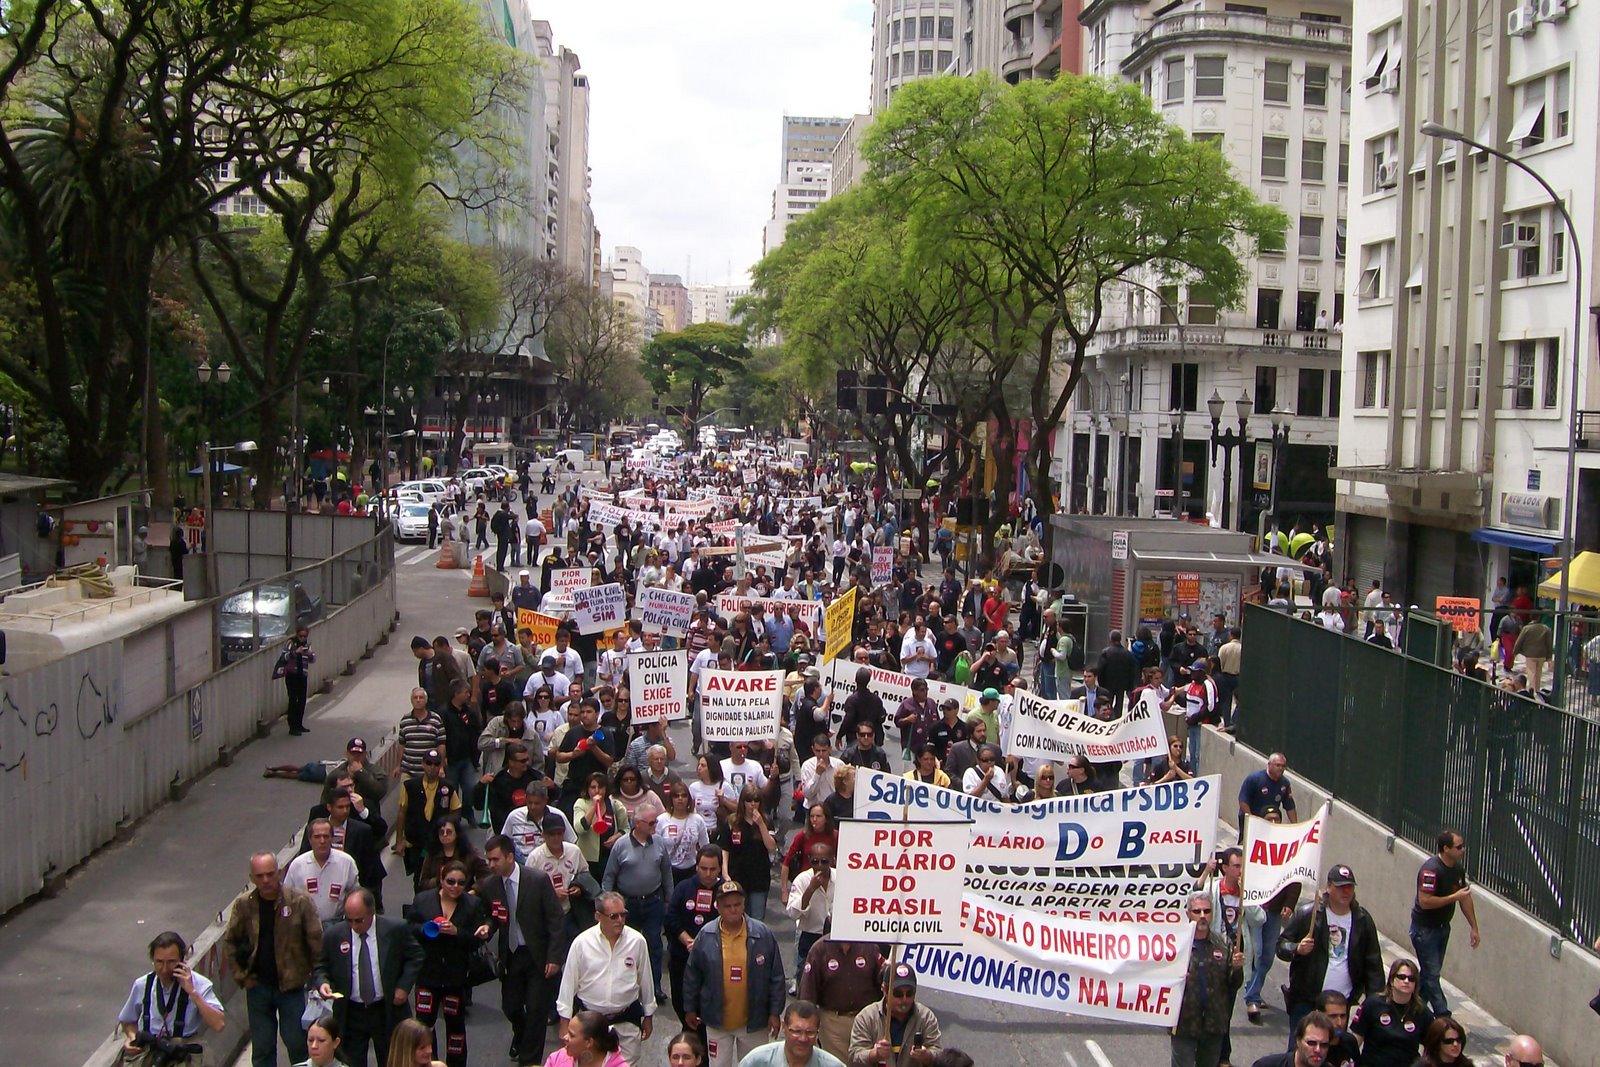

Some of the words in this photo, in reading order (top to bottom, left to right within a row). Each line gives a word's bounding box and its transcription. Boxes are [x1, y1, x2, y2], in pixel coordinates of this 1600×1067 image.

[553, 578, 587, 587] SALÁRIO
[561, 570, 580, 578] PIOR
[574, 587, 602, 602] POLÍCIA
[649, 590, 677, 604] CHEGA
[679, 596, 690, 606] DE
[592, 611, 616, 622] SIM
[1440, 604, 1476, 618] OURO
[643, 610, 670, 626] POLÍCIA
[672, 617, 690, 630] CIVIL
[531, 632, 551, 644] OSO
[638, 653, 678, 670] POLÍCIA
[644, 672, 670, 685] CIVIL
[706, 674, 777, 692] AVARÉ
[824, 676, 856, 695] Puniçã
[868, 667, 911, 688] OVERNAD
[643, 686, 672, 701] EXIGE
[712, 697, 724, 707] NA
[726, 697, 747, 707] LUTA
[749, 696, 770, 707] PELA
[635, 702, 681, 718] RESPEITO
[705, 710, 742, 721] DIGNIDADE
[743, 710, 775, 721] SALARIAL
[1019, 696, 1057, 724] CHEGA
[1057, 713, 1078, 731] DE
[1077, 720, 1107, 736] NOS
[705, 726, 715, 736] DA
[716, 723, 744, 736] POLÍCIA
[745, 724, 774, 736] PAULISTA
[1016, 733, 1035, 748] COM
[1036, 736, 1041, 748] A
[1042, 736, 1076, 756] CONVERSA
[1076, 745, 1087, 756] DA
[869, 774, 929, 808] Sabe
[936, 790, 951, 809] o
[874, 829, 934, 847] PIOR
[968, 829, 1045, 850] ALÁRIO
[1117, 821, 1203, 860] BRASIL
[1249, 820, 1321, 866] AVAE
[847, 848, 956, 871] SALÁRIO
[881, 875, 916, 893] DO
[964, 877, 1047, 893] POLICIAIS
[1053, 882, 1120, 896] PEDEM
[1124, 883, 1191, 896] REPOS
[852, 897, 942, 915] BRASIL
[1031, 895, 1112, 908] APARTIR
[1119, 899, 1147, 909] DA
[864, 918, 910, 933] POLÍCIA
[913, 920, 943, 933] CIVIL
[972, 906, 1018, 944] ESTÁ
[1023, 921, 1035, 947] O
[1040, 924, 1131, 961] DINHEIRO
[1138, 933, 1178, 962] DOS
[901, 943, 1071, 1001] FUNCIONÁRIOS
[1078, 976, 1109, 1008] NA
[1115, 981, 1172, 1016] L.R.F.
